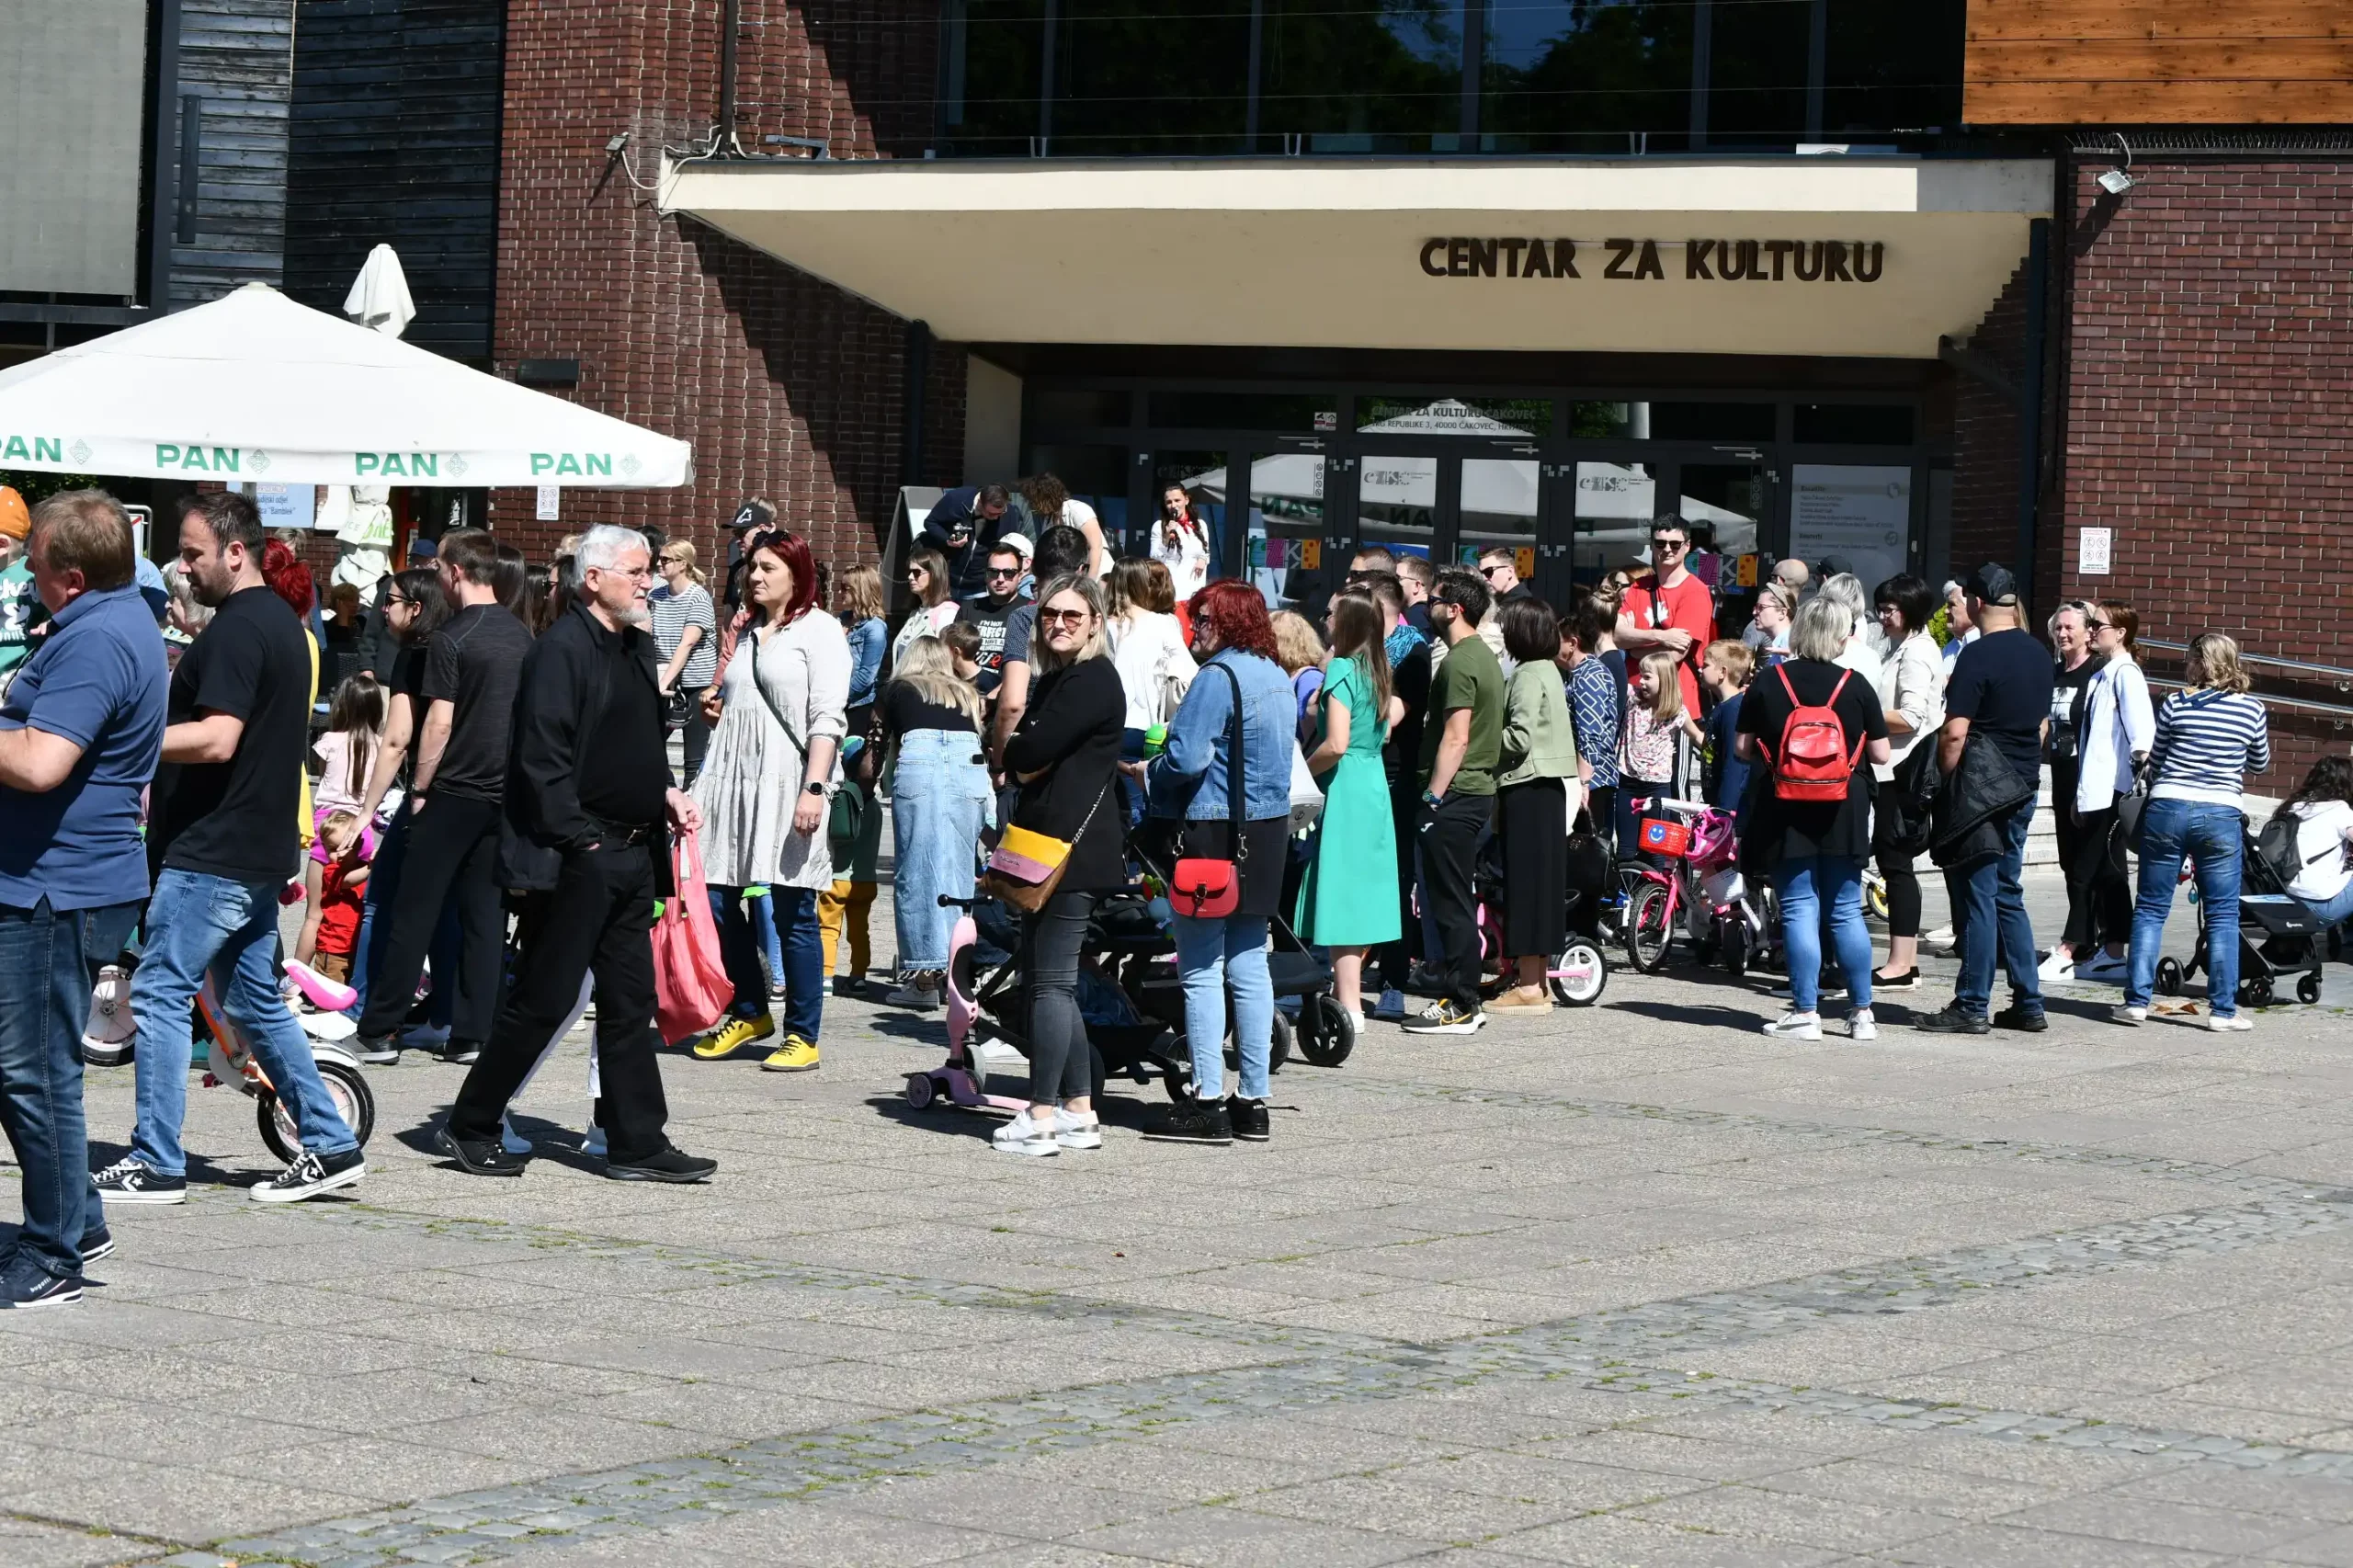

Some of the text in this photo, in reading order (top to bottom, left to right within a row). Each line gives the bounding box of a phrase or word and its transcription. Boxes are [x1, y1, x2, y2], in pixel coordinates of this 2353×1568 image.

[1420, 238, 1884, 283] CENTAR ZA KULTURU
[1388, 420, 1424, 428] REPUBLIKE
[1434, 421, 1457, 429] 40000
[1415, 407, 1429, 416] ZA
[1433, 407, 1481, 418] KULTURU
[0, 436, 62, 462] AN
[156, 444, 240, 472] PAN
[356, 452, 438, 477] PAN
[530, 452, 612, 476] PAN
[29, 1276, 51, 1292] bugatti
